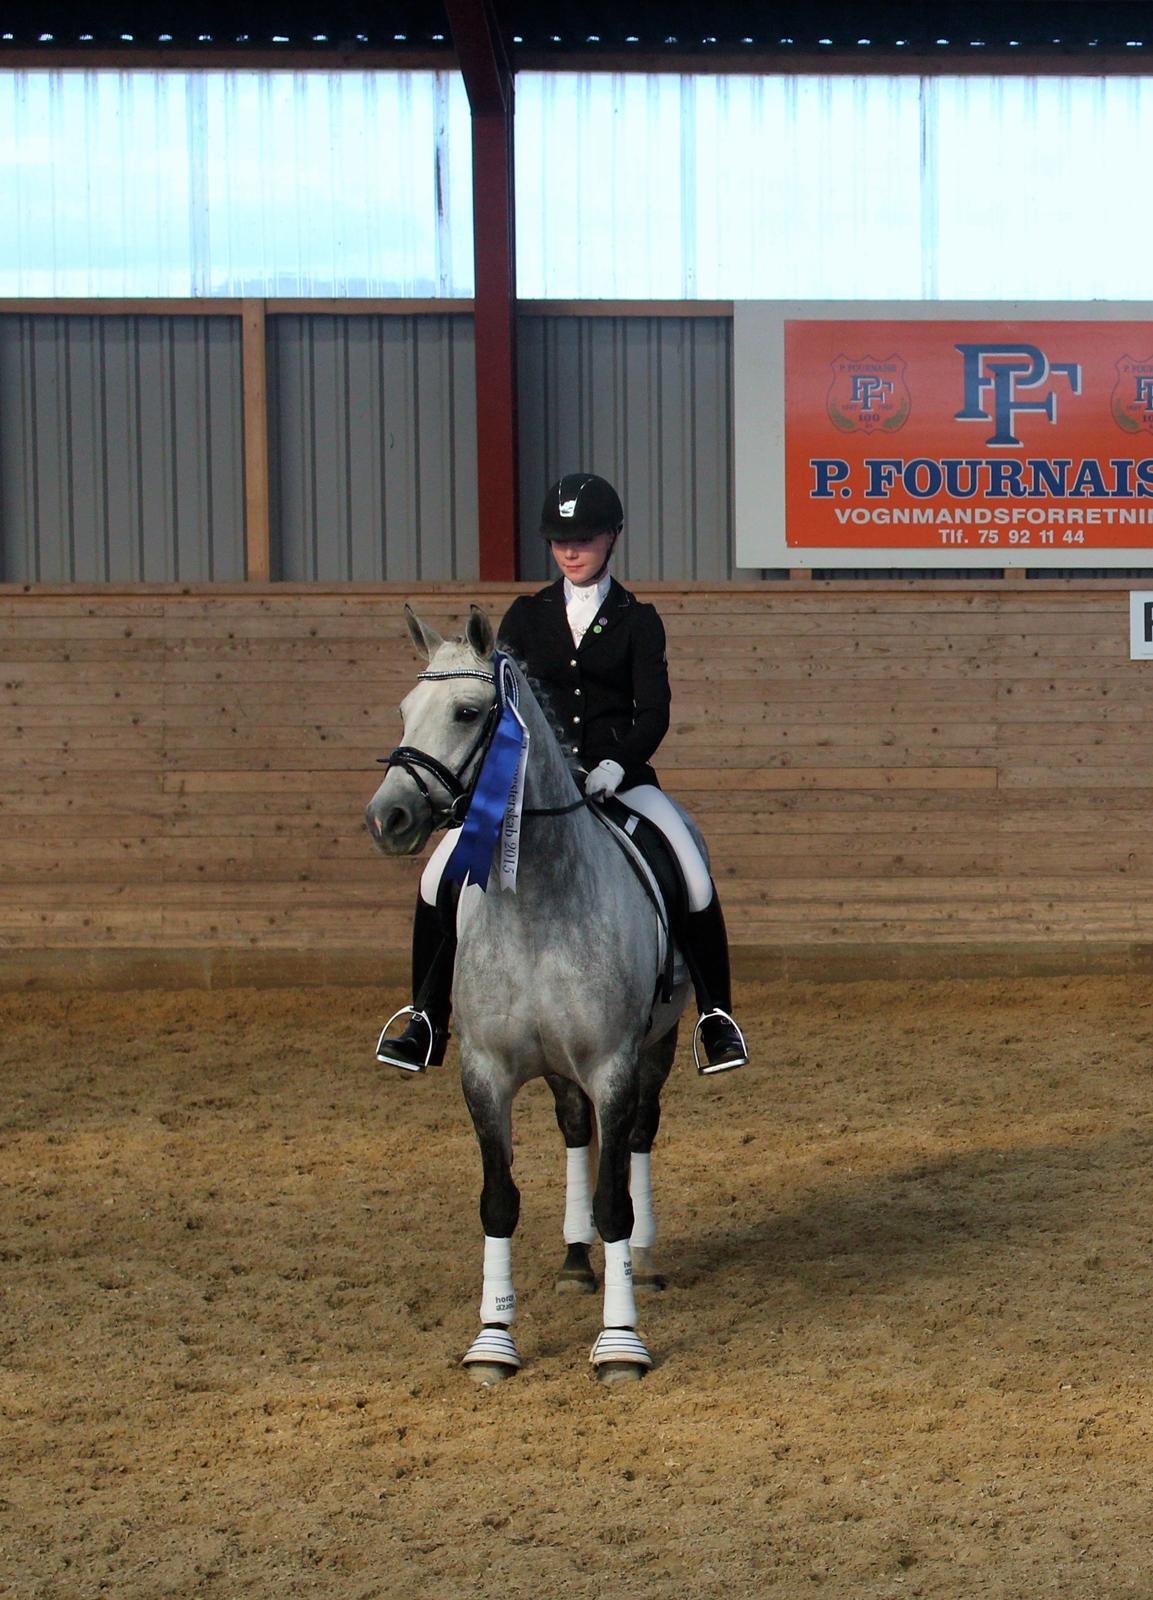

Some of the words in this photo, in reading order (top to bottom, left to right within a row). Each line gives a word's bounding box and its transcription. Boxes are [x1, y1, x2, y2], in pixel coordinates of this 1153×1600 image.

[809, 458, 852, 498] P.
[863, 457, 1153, 498] FOURNAIS
[834, 508, 1153, 524] VOGNMANDSFORRETNI
[938, 529, 969, 544] Tlf.
[978, 529, 999, 544] 75
[1008, 529, 1030, 544] 92
[1039, 529, 1054, 544] 11
[1062, 529, 1085, 544] 44
[503, 842, 517, 874] 2015
